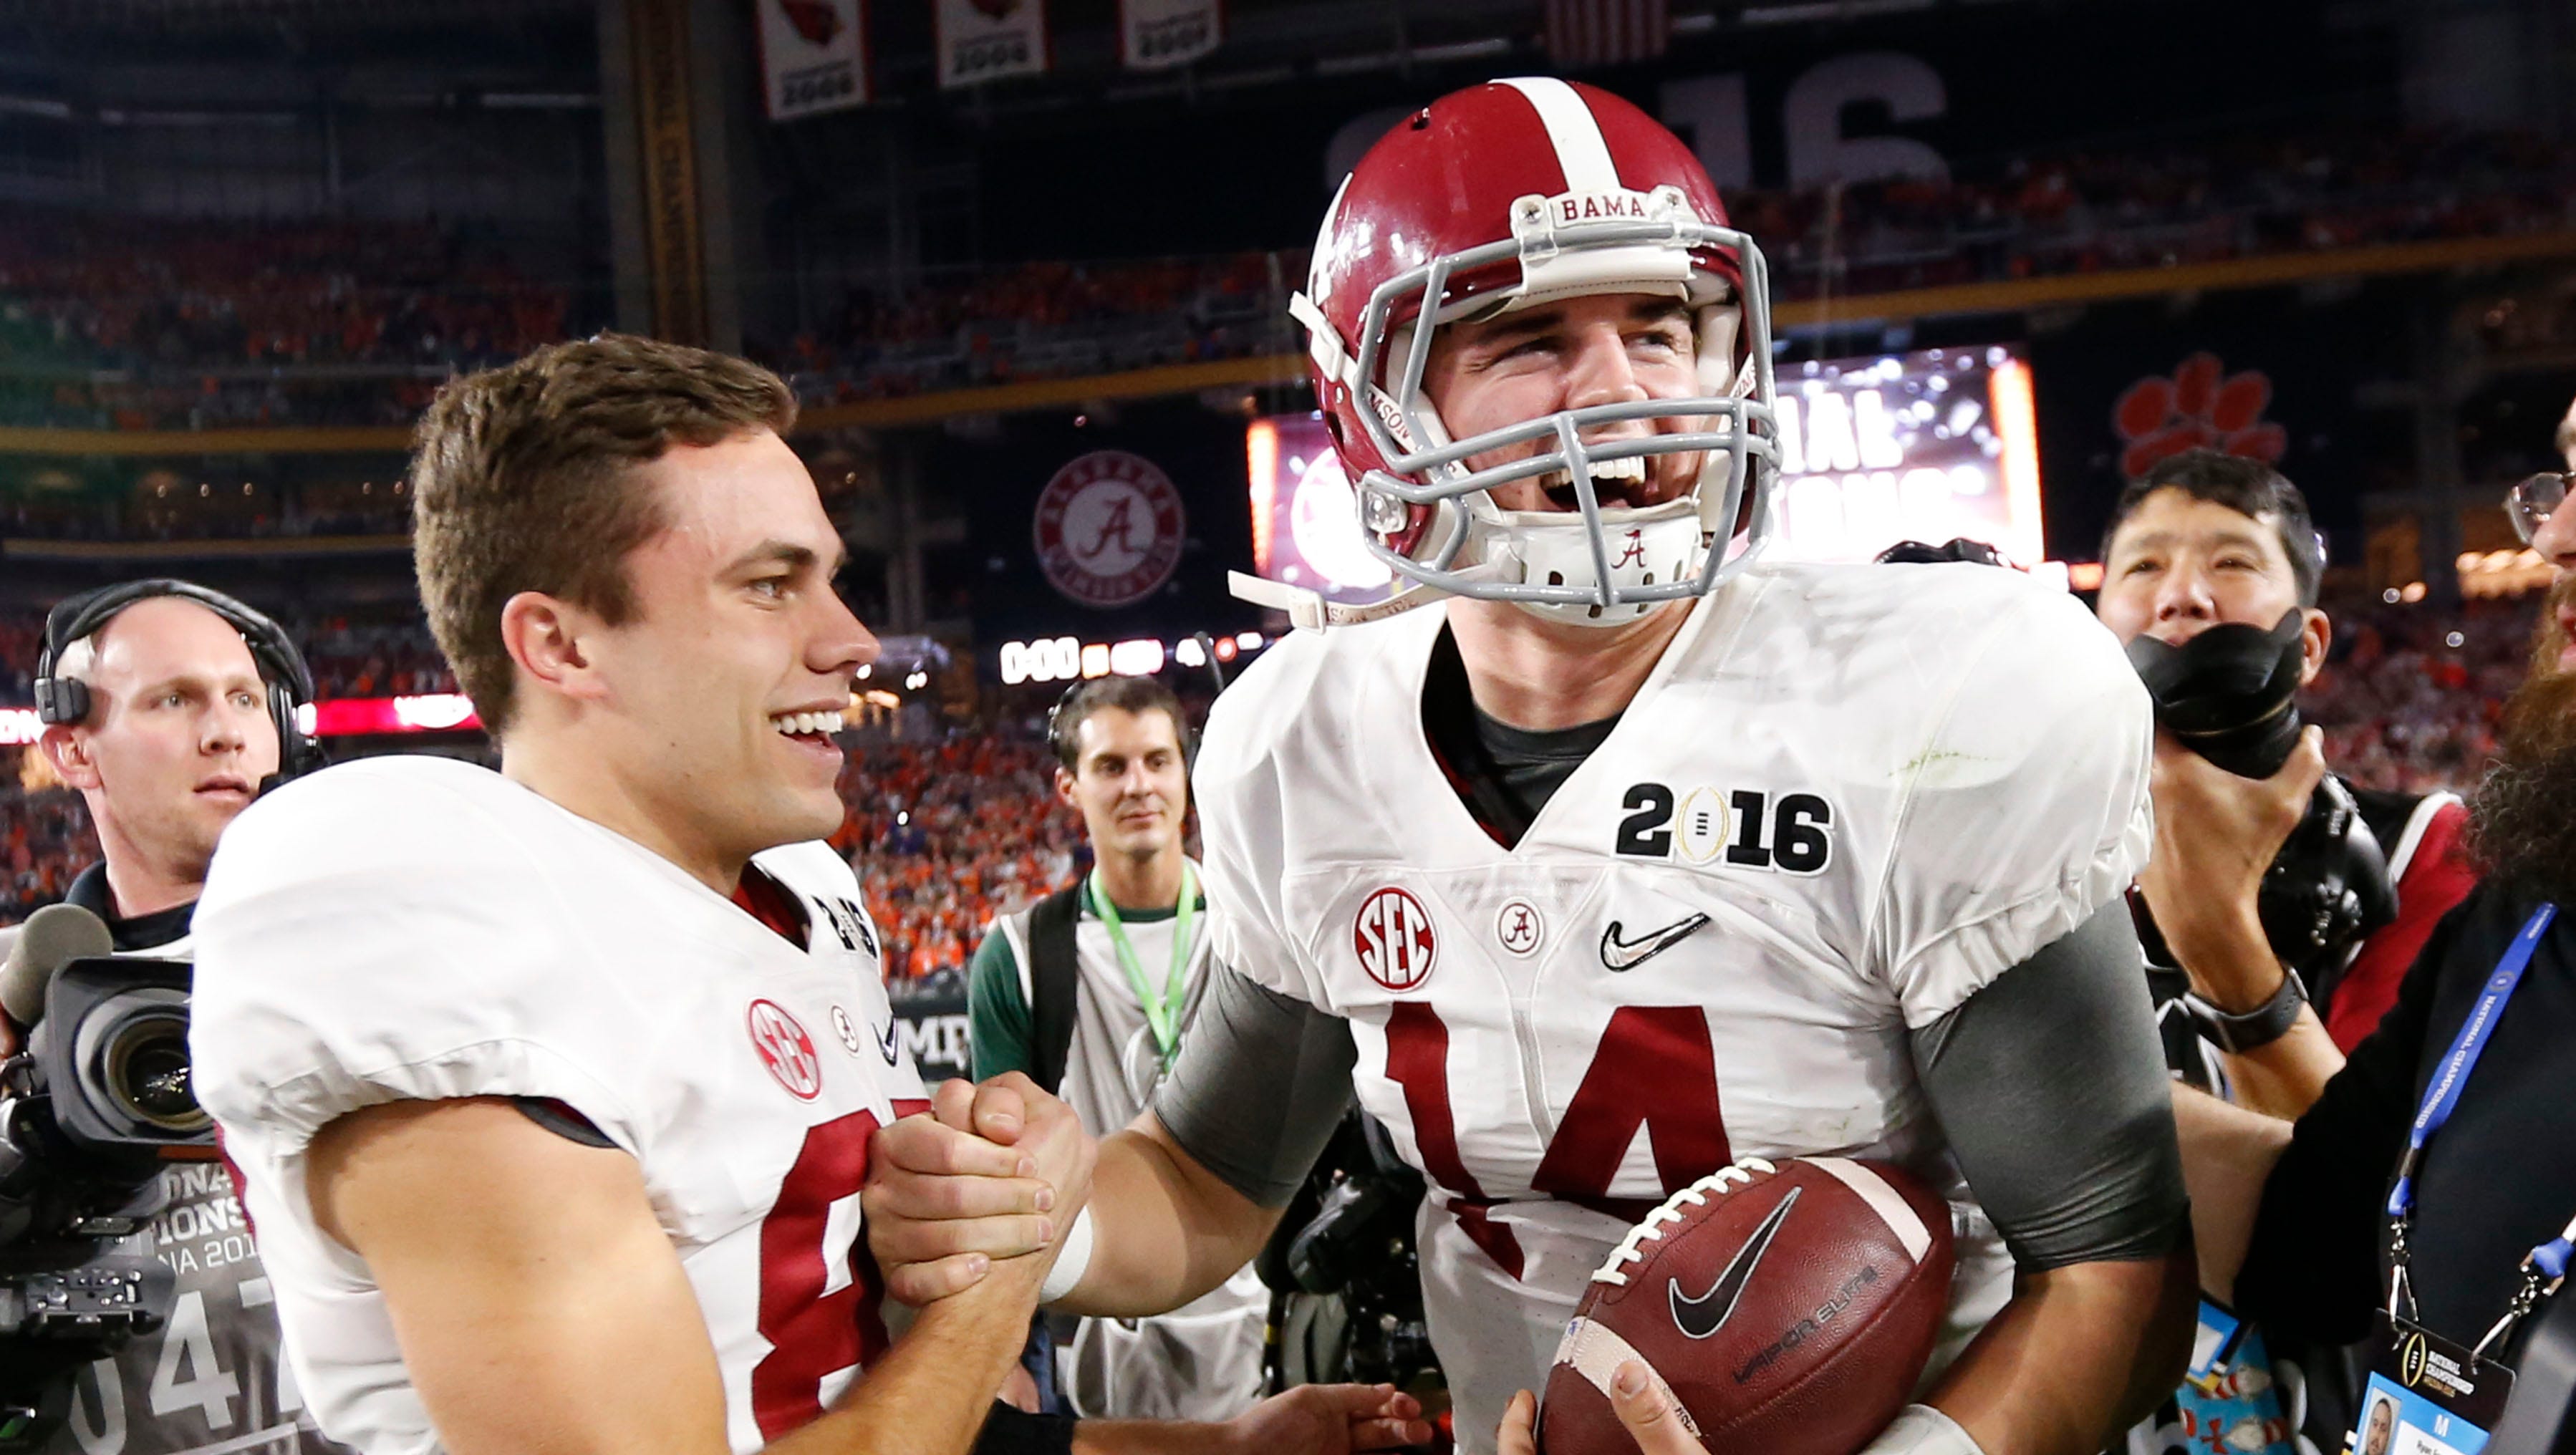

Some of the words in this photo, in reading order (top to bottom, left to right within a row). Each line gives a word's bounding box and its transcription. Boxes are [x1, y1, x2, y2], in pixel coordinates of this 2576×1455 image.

[1560, 195, 1646, 221] BAMA
[1369, 390, 1409, 439] MSON
[1076, 496, 1147, 559] A
[1611, 529, 1646, 569] A
[1358, 893, 1432, 986] SEC
[1505, 909, 1532, 943] A
[203, 1232, 257, 1268] 201
[2434, 1413, 2450, 1438] M
